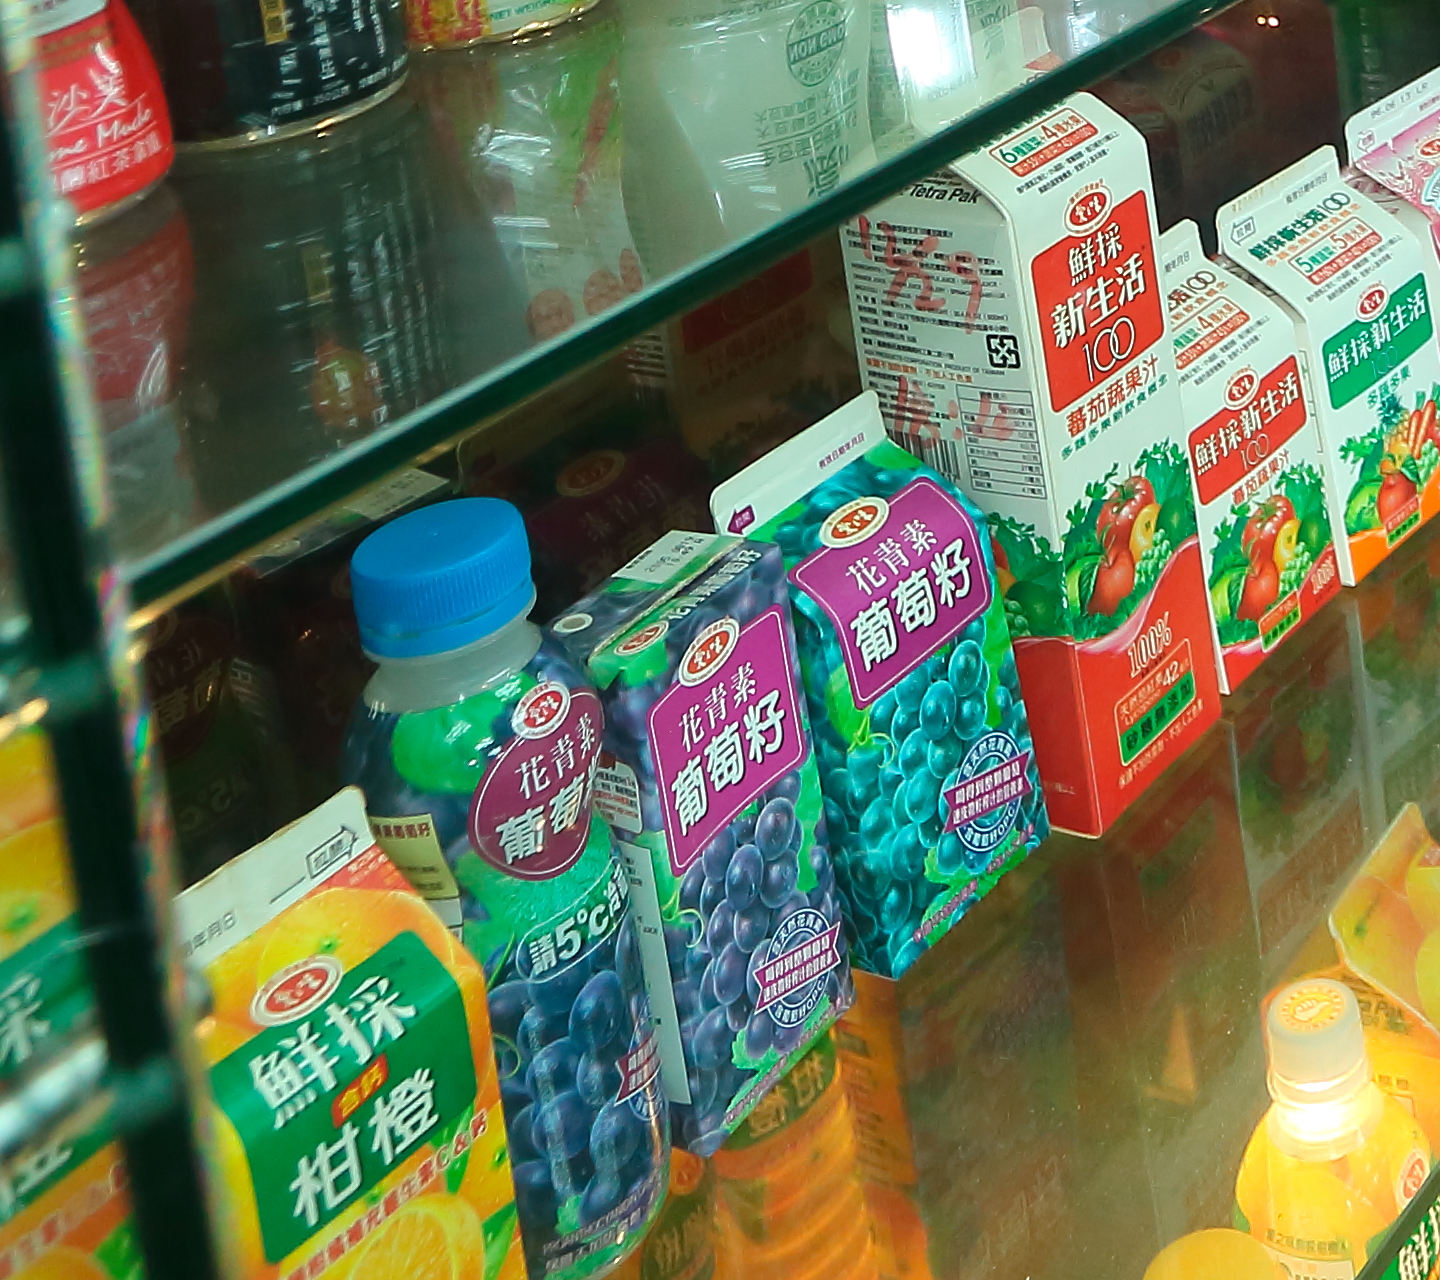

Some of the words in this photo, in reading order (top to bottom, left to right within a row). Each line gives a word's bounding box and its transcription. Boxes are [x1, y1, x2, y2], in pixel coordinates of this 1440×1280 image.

[909, 182, 949, 201] Tetra
[948, 186, 983, 205] Pak
[1049, 252, 1147, 349] 新生活
[1067, 221, 1125, 289] 鮮採
[1327, 288, 1428, 381] 鮮採新生活
[1195, 373, 1300, 477] 鮮採新生活
[844, 519, 939, 596] 花青素
[849, 537, 973, 675] 葡萄籽
[1128, 610, 1173, 680] 100%
[678, 660, 758, 754] 花青素
[514, 711, 598, 801] 花青素
[671, 688, 786, 838] 葡萄籽
[247, 974, 418, 1132] 鮮採
[287, 1066, 441, 1228] 柑橙
